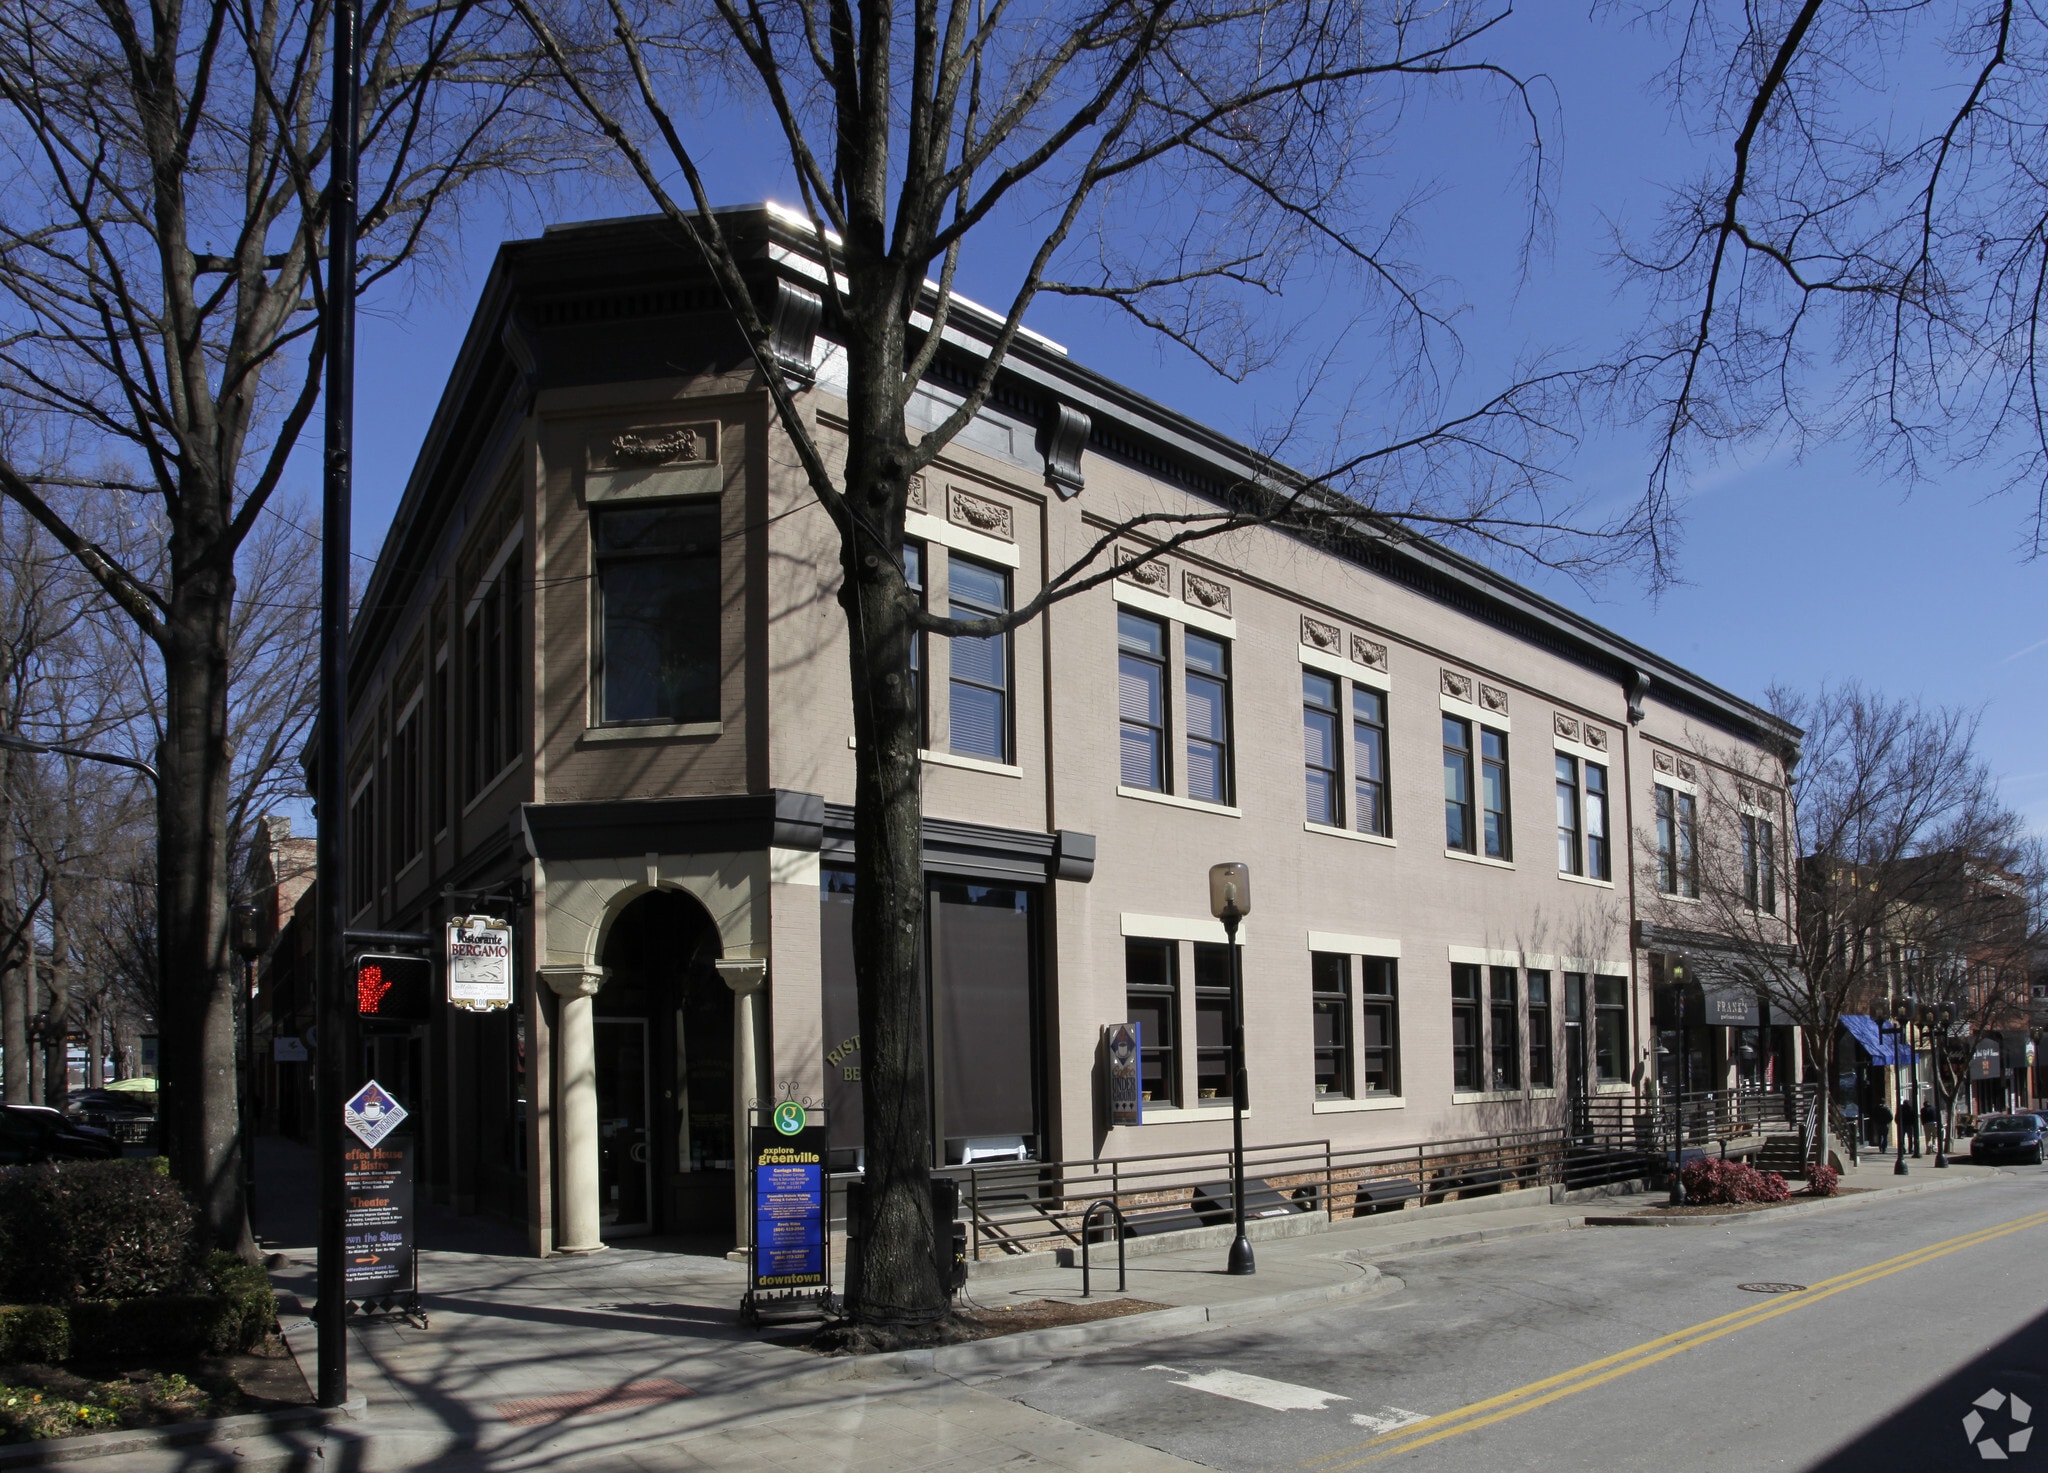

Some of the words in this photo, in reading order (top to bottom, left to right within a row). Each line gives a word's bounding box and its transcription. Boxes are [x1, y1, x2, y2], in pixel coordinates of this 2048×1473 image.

[456, 928, 502, 944] Ristorante
[452, 944, 508, 958] BERGAMO
[826, 1034, 860, 1067] RIST
[844, 1066, 861, 1080] BE
[1112, 1077, 1136, 1091] UNDER
[345, 1110, 368, 1135] Coffee
[365, 1108, 404, 1144] UNDERGROUND
[345, 1148, 370, 1160] offee
[373, 1148, 402, 1159] House
[764, 1146, 794, 1156] explore
[360, 1160, 388, 1170] Bistro
[758, 1152, 819, 1166] greenville
[350, 1197, 390, 1207] Theater
[364, 1233, 378, 1242] the
[380, 1231, 402, 1242] Steps
[759, 1274, 821, 1286] downtown
